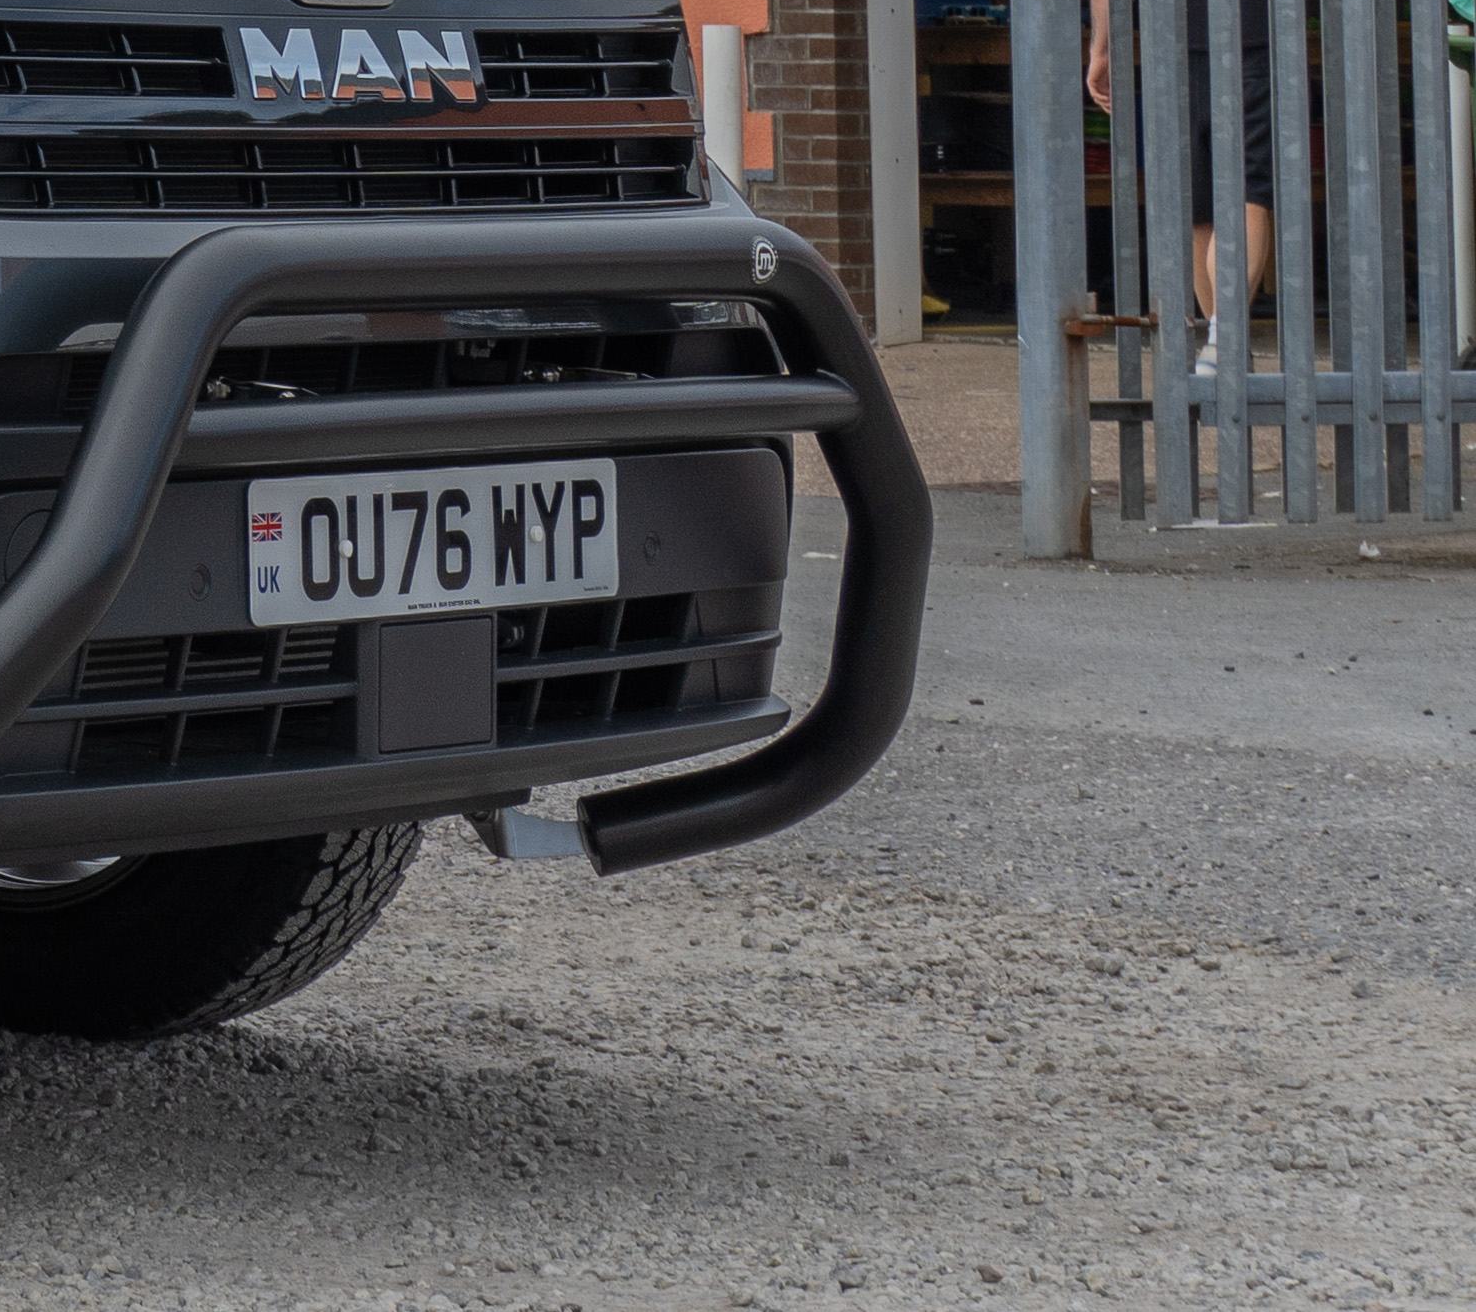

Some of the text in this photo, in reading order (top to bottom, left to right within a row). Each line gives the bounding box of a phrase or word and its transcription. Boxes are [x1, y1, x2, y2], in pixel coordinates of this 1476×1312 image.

[239, 27, 477, 102] MAN
[301, 479, 605, 602] OU76 WYP
[257, 565, 281, 593] UK
